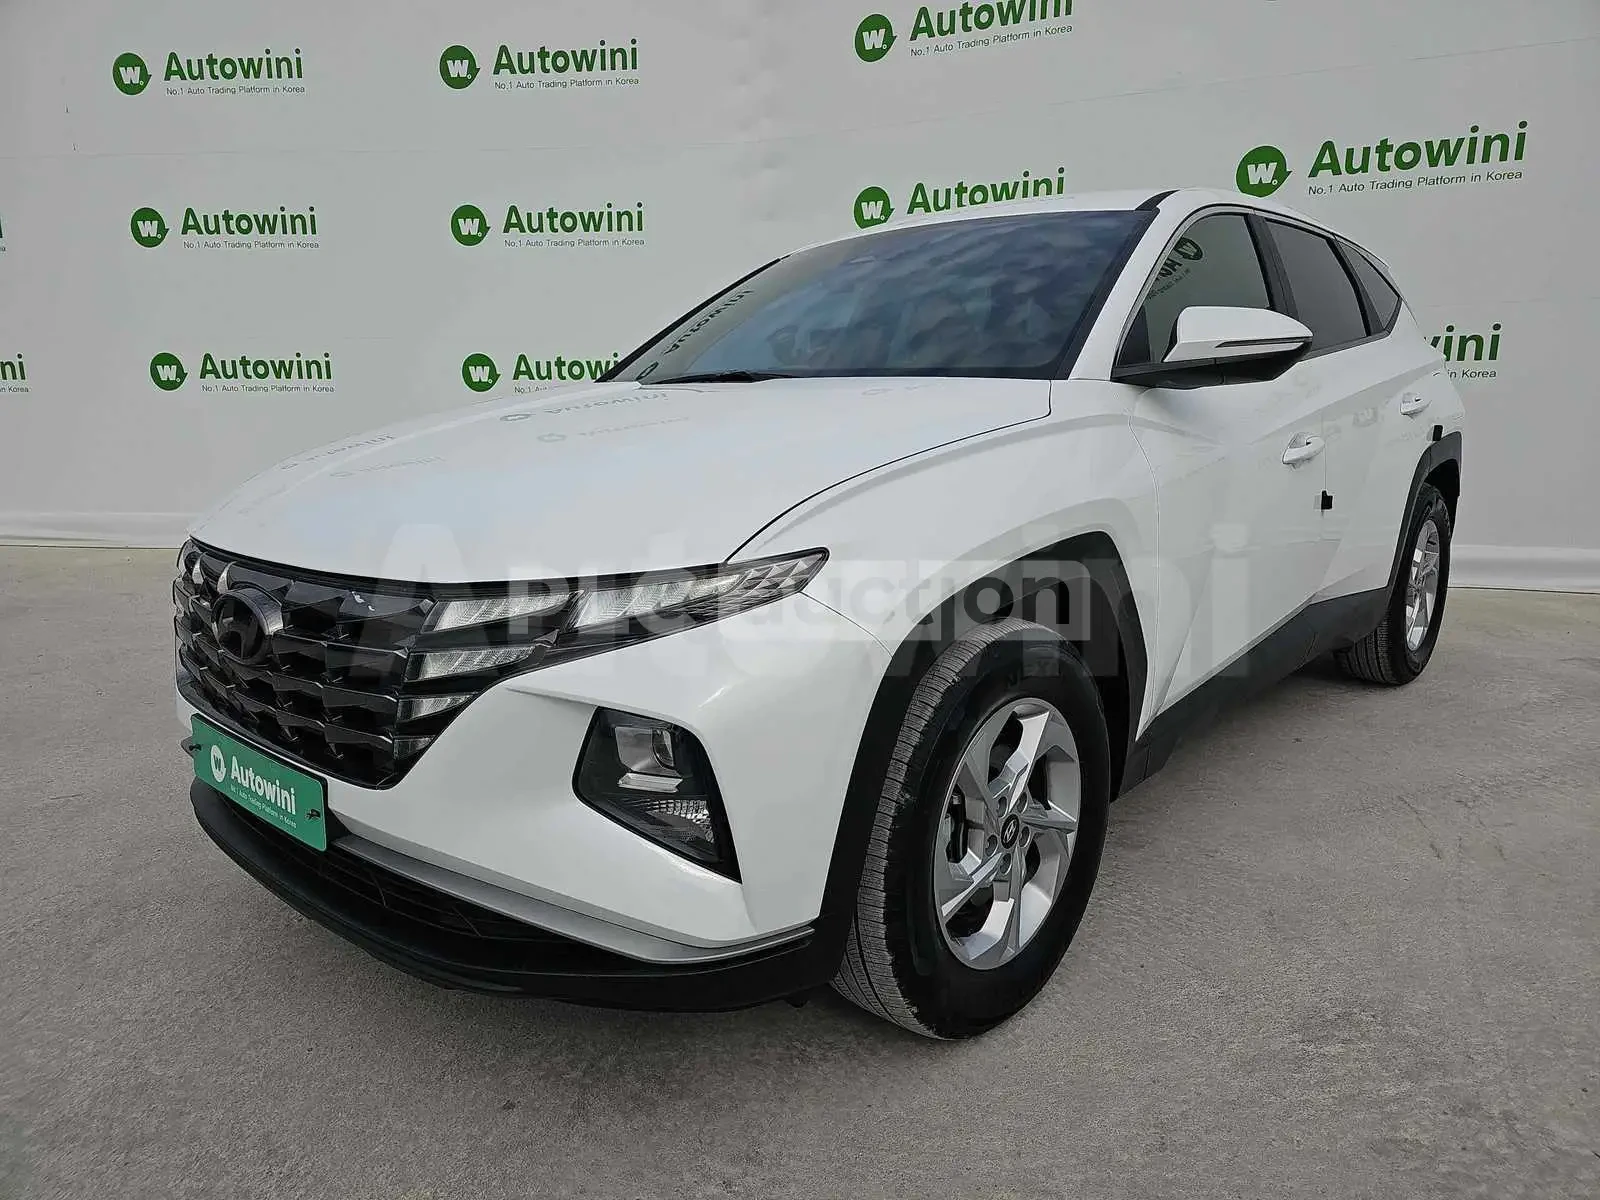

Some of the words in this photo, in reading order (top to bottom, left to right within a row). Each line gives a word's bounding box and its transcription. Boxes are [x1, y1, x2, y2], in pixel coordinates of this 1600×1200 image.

[934, 44, 954, 54] Auto
[958, 38, 990, 49] Trading
[993, 31, 1030, 44] Platform
[1033, 30, 1042, 38] in
[1045, 25, 1073, 35] Korea
[164, 48, 302, 81] Autowini
[493, 38, 637, 75] Autowini
[188, 86, 205, 95] Auto
[208, 86, 236, 95] Trading
[239, 85, 271, 93] Platform
[283, 85, 305, 93] Korea
[516, 81, 535, 89] Auto
[538, 80, 567, 89] Trading
[570, 78, 603, 87] Platform
[616, 77, 639, 85] Korea
[1308, 120, 1528, 178] Autowini
[907, 167, 1064, 214] Autowini
[1308, 185, 1334, 196] No.1
[1339, 182, 1365, 193] Auto
[1370, 179, 1413, 191] Trading
[1418, 174, 1466, 186] Platform
[1471, 172, 1481, 182] in
[1487, 170, 1522, 181] Korea
[181, 206, 317, 235] Autowini
[503, 202, 643, 233] Autowini
[204, 240, 221, 248] Auto
[224, 240, 252, 249] Trading
[254, 240, 285, 248] Platform
[288, 240, 294, 248] in
[297, 240, 319, 248] Korea
[526, 239, 543, 247] Auto
[547, 239, 575, 248] Trading
[612, 238, 619, 246] in
[200, 352, 332, 380] Autowini
[1462, 369, 1496, 378] Korea
[222, 384, 239, 392] Auto
[241, 384, 269, 393] Trading
[231, 755, 296, 815] Autowini
